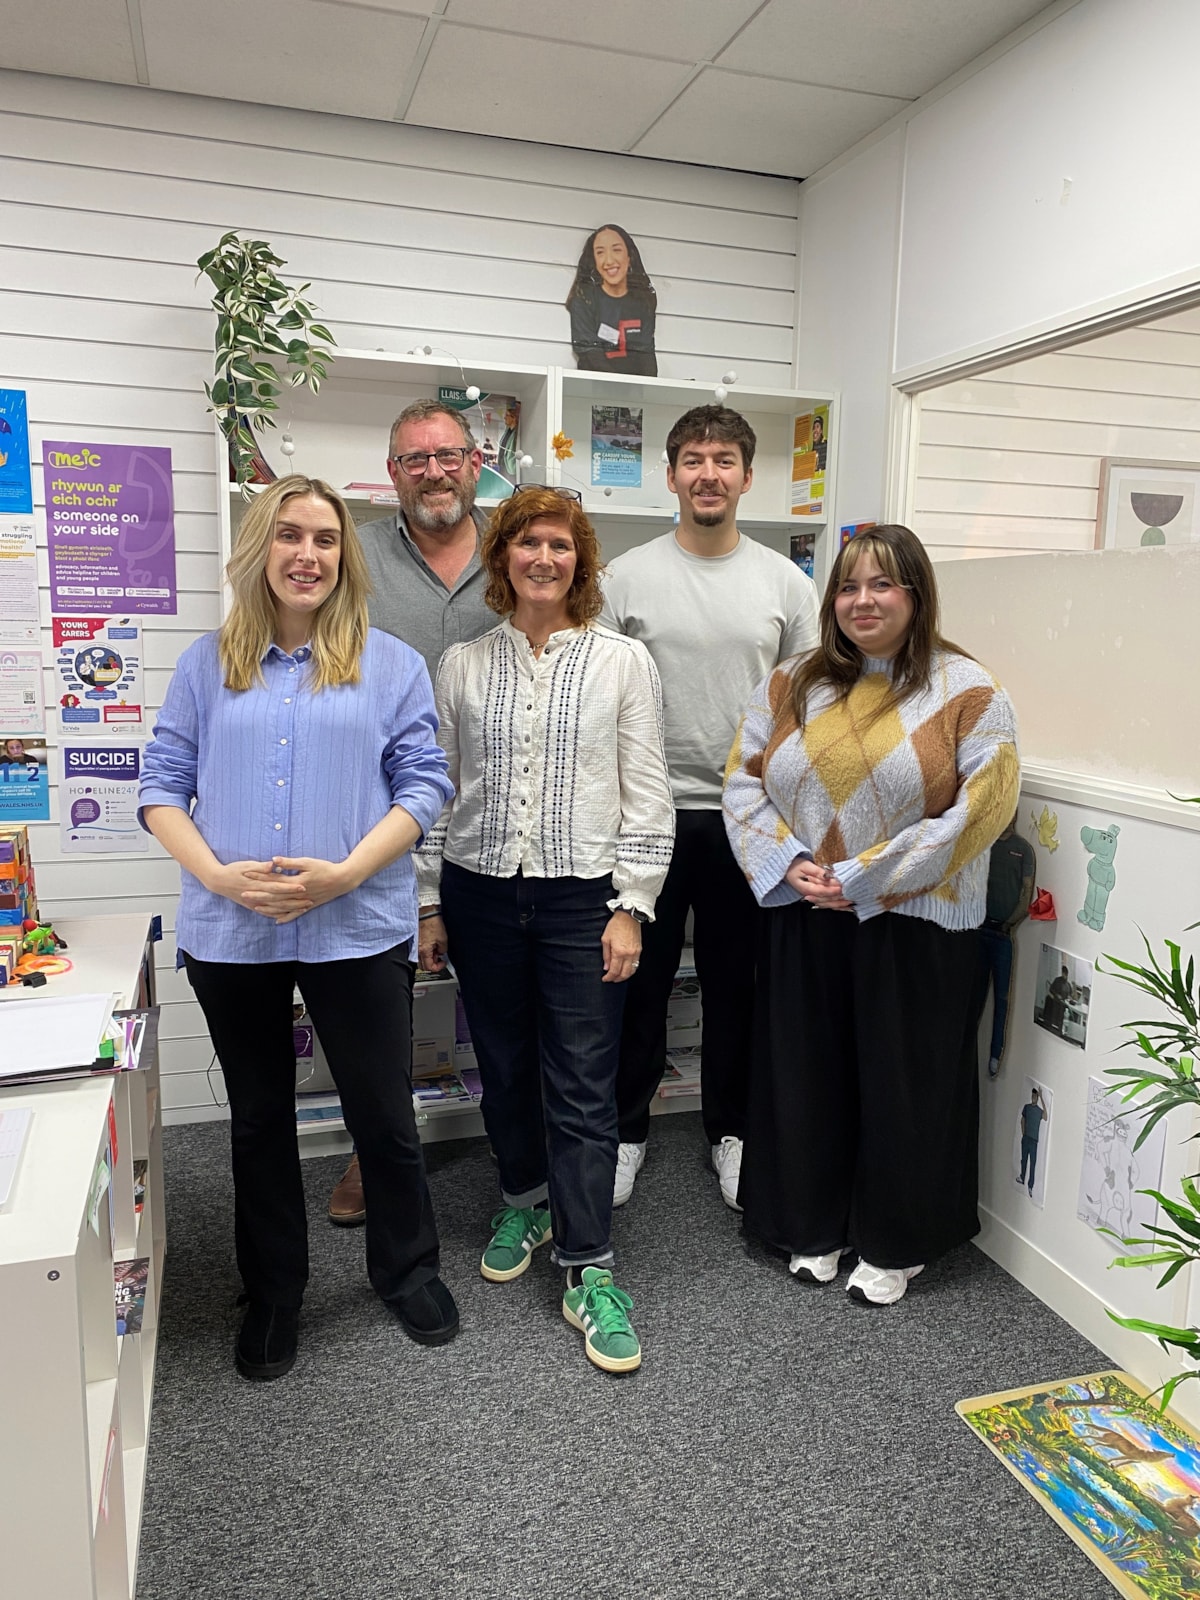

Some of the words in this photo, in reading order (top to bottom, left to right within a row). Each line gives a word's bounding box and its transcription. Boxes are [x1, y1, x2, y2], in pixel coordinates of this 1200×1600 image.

[441, 389, 460, 400] LLAIS
[51, 478, 104, 493] rhywun
[108, 483, 122, 493] ar
[52, 493, 82, 505] eich
[85, 495, 118, 507] ochr
[53, 511, 118, 522] someone
[121, 514, 139, 523] on
[53, 524, 87, 536] your
[90, 524, 119, 536] side
[60, 621, 88, 629] YOUNG
[69, 752, 135, 765] SUICIDE
[27, 767, 39, 782] 2
